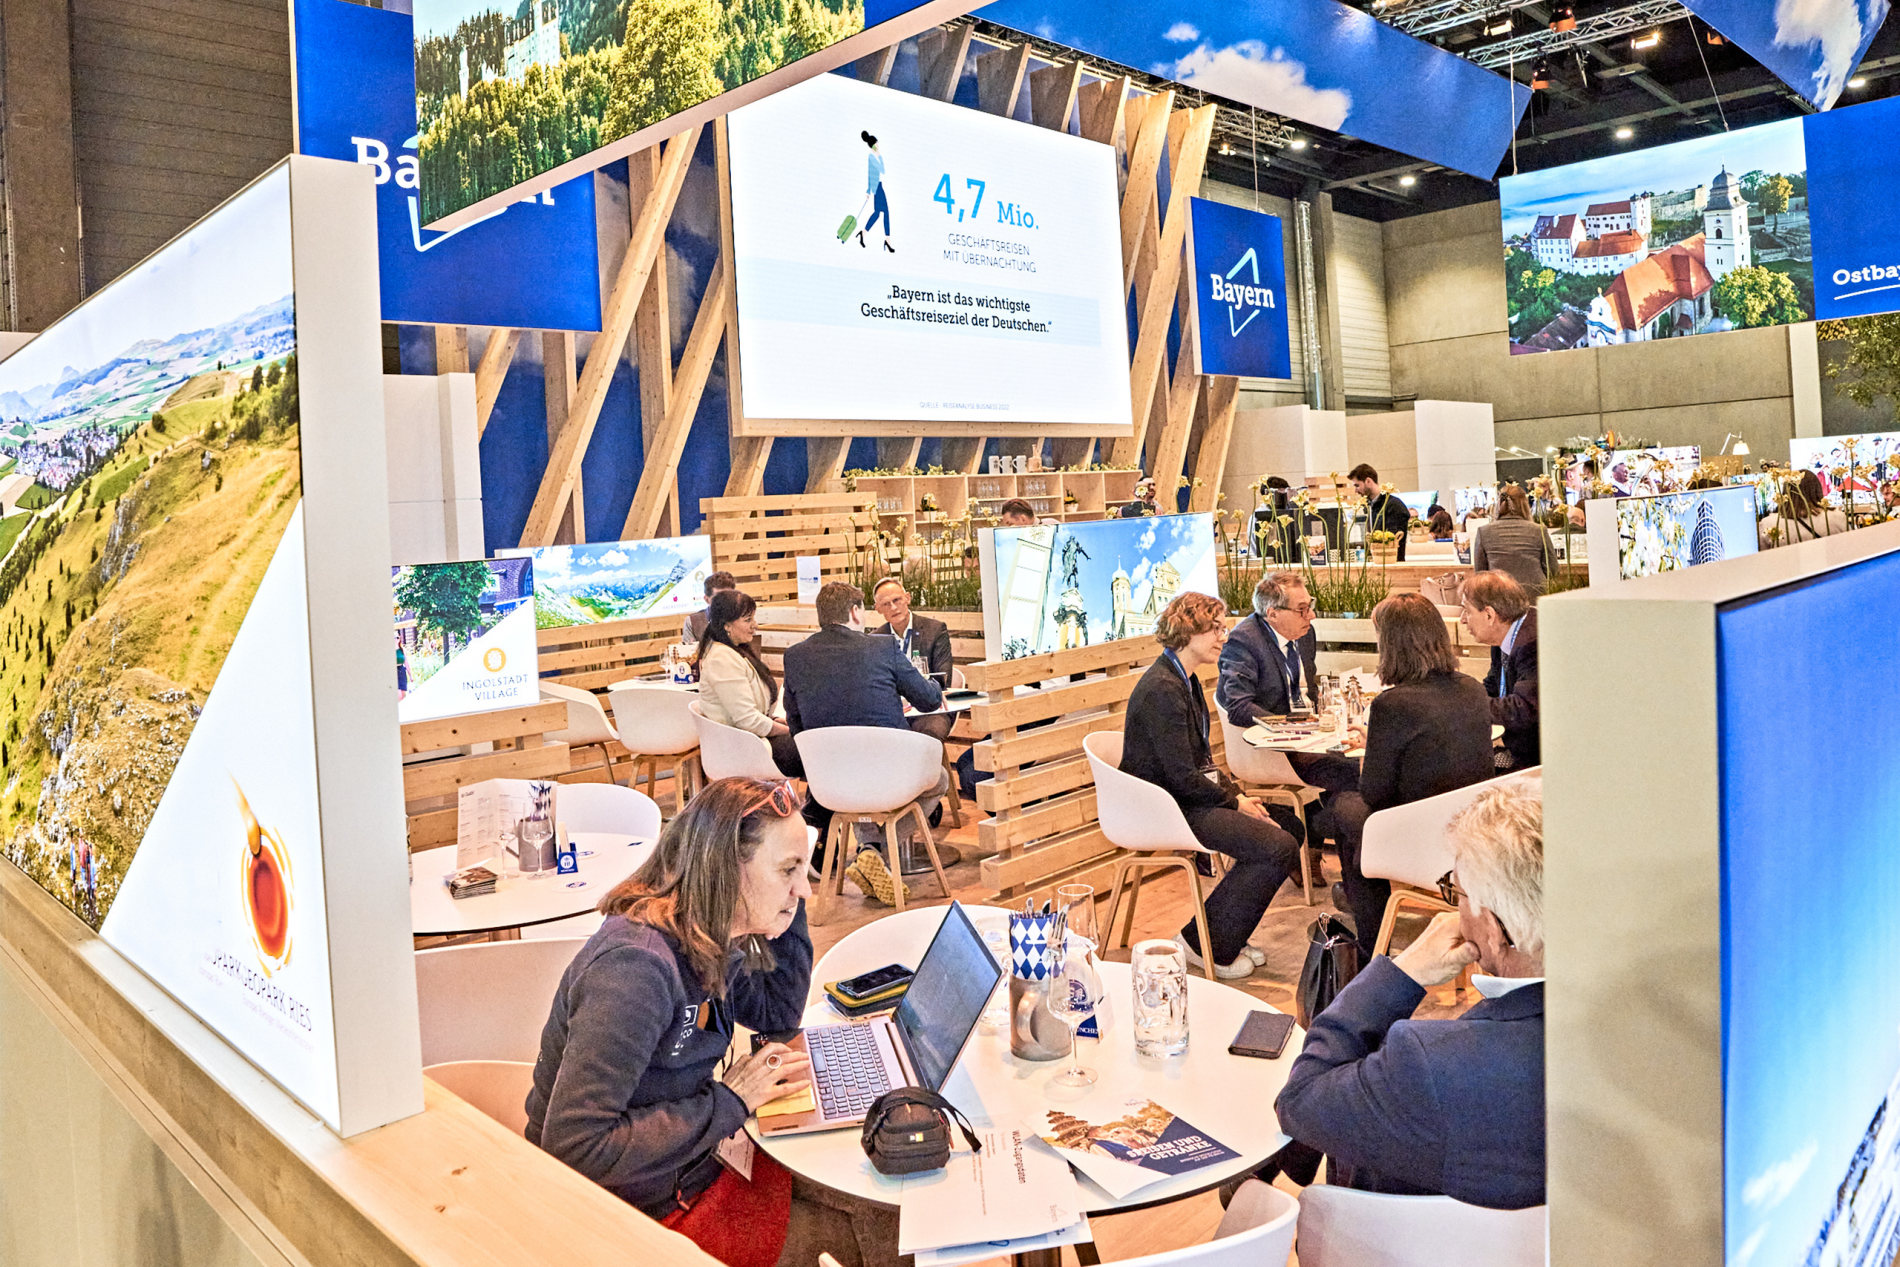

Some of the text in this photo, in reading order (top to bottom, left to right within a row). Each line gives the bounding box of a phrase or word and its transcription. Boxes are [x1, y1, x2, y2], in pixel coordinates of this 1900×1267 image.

[933, 173, 1039, 230] 4,7 Mio.
[948, 233, 1030, 256] GESCHÄFTSREISEN
[943, 250, 1036, 273] MIT ÜBERNACHTUNG
[937, 290, 951, 304] ist
[954, 292, 973, 306] das
[975, 296, 1031, 314] wichtigste
[1210, 273, 1275, 310] Bayern
[860, 302, 969, 326] Geschäftsreiseziel
[971, 313, 989, 328] der
[462, 673, 529, 691] INGOLSTADT
[474, 686, 519, 701] VILLAGE
[242, 965, 287, 1015] GEOPARK
[288, 996, 312, 1032] RIES
[1126, 1141, 1176, 1158] SPEISEN
[1173, 1135, 1202, 1147] UND
[1149, 1140, 1212, 1160] GETRÄNKE
